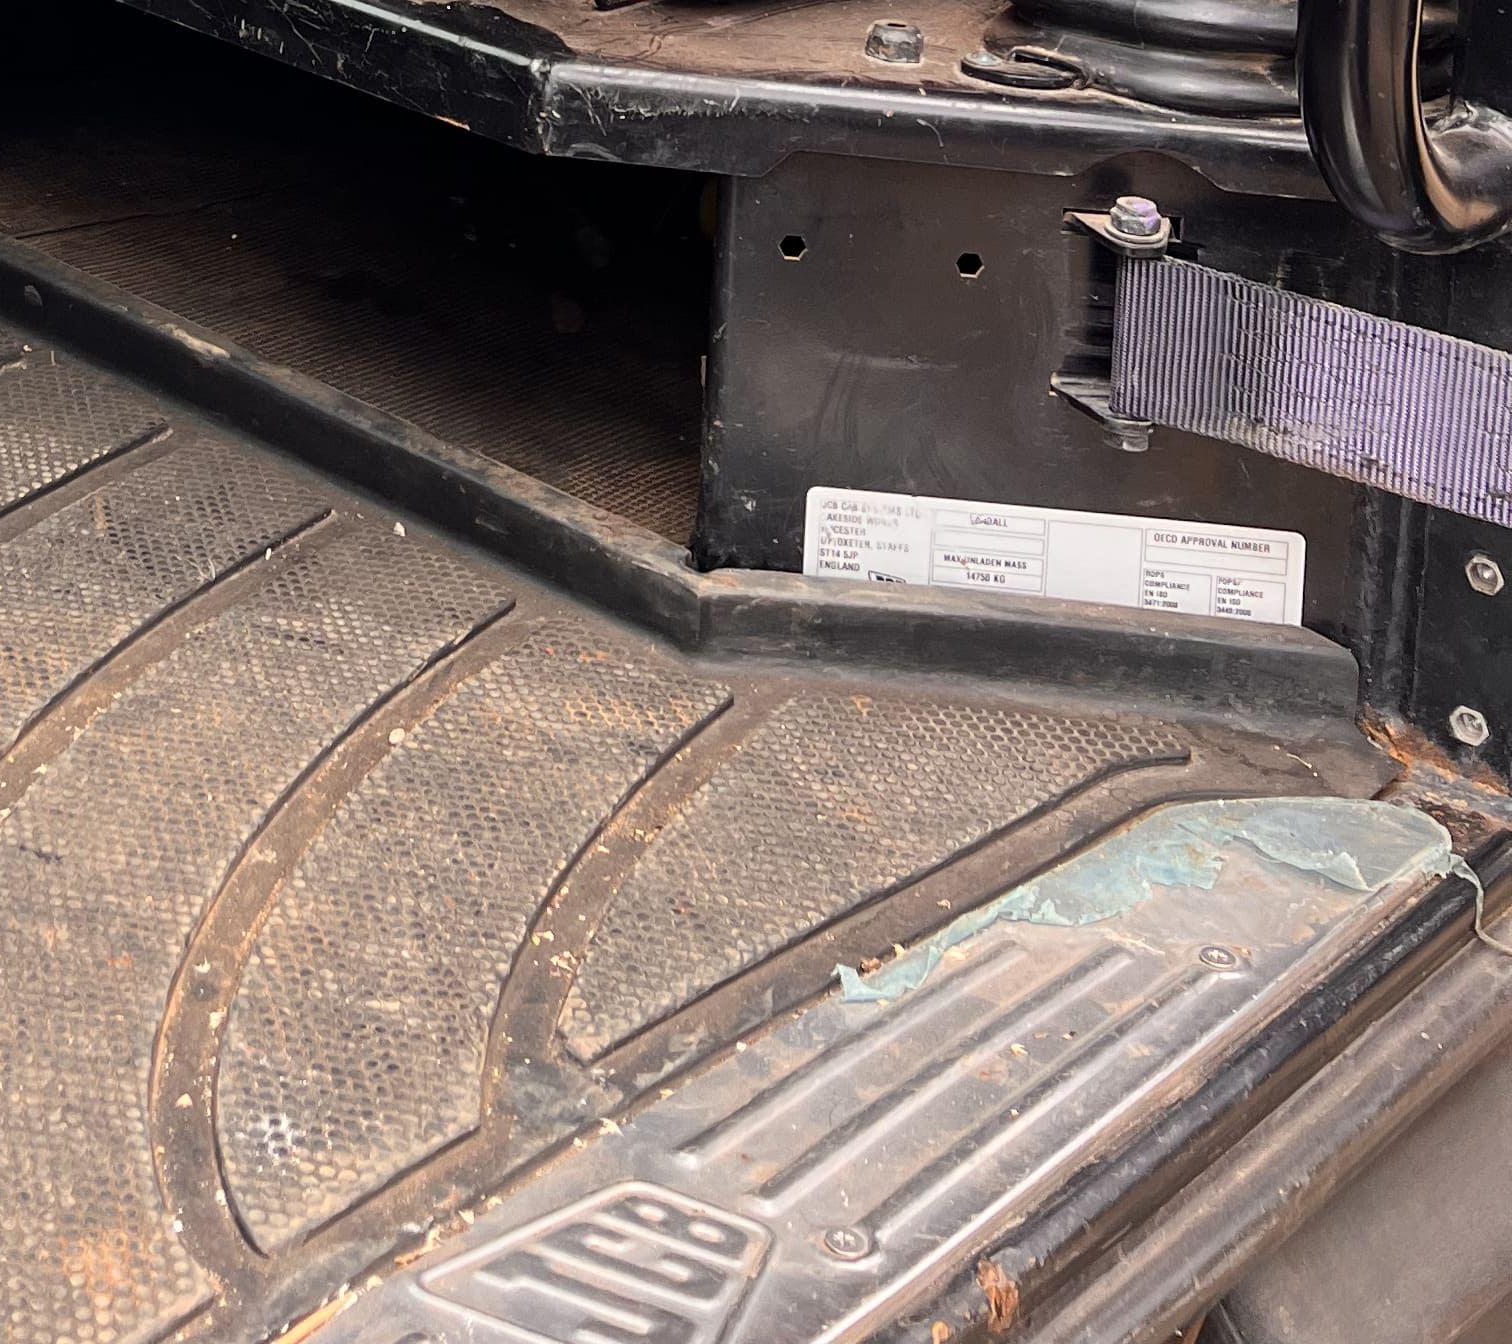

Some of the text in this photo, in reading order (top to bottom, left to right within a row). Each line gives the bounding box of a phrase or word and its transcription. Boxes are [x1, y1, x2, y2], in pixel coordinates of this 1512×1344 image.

[826, 513, 862, 523] AKESIDE
[1154, 533, 1269, 552] OECD APPROVAL NUMBER
[819, 548, 857, 559] ST14 5JP
[819, 560, 859, 571] ENGLAND
[1004, 560, 1026, 568] MASS
[1144, 580, 1189, 590] COMPLIANCE
[1217, 587, 1262, 598] COMPLIANCE
